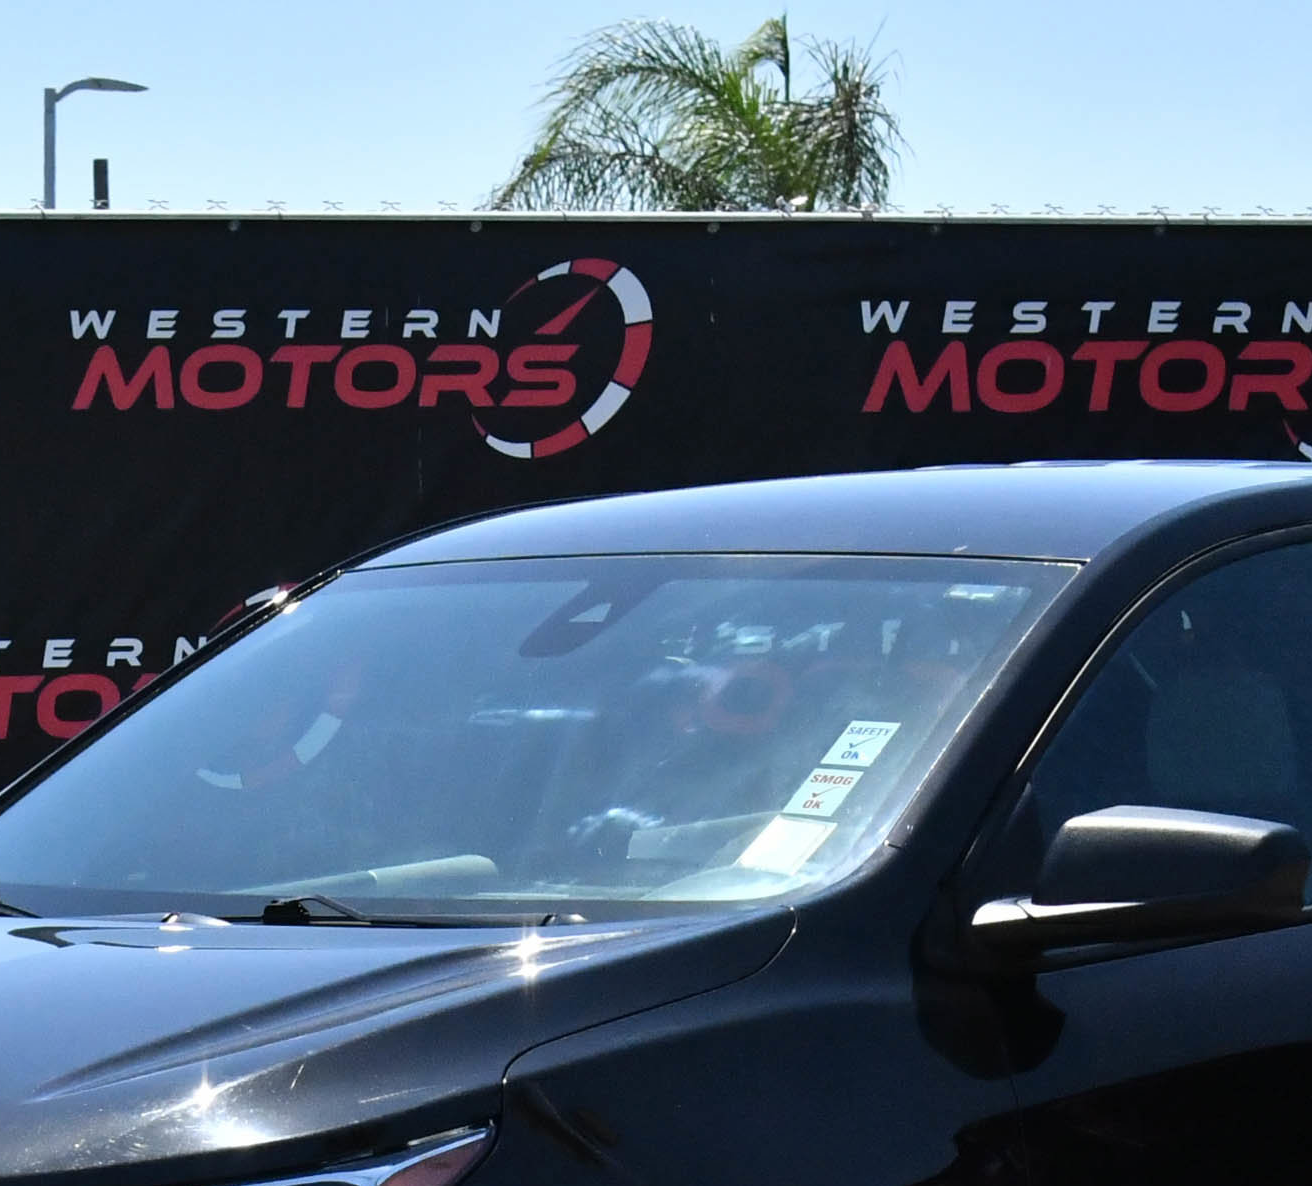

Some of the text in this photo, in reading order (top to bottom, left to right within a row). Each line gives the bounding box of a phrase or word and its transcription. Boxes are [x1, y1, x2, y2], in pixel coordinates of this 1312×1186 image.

[70, 309, 501, 340] WESTERN
[71, 344, 579, 411] MOTORS
[847, 726, 893, 737] SAFETY
[811, 774, 854, 786] SMOG
[803, 799, 822, 809] OK
